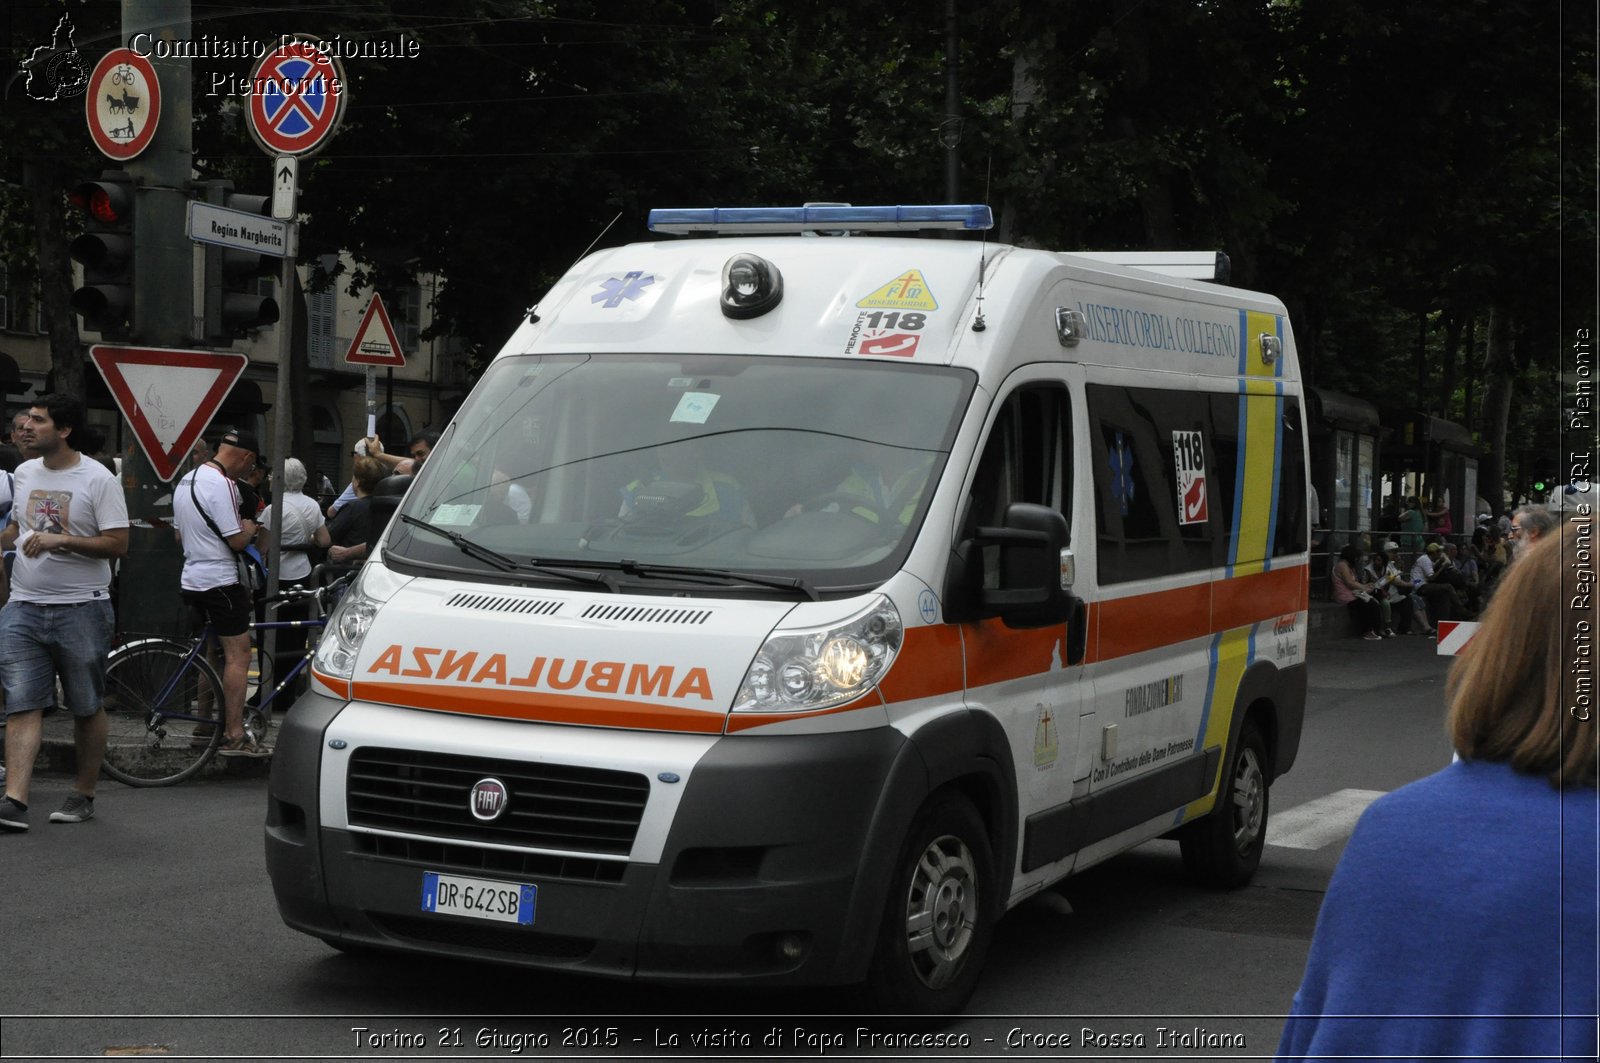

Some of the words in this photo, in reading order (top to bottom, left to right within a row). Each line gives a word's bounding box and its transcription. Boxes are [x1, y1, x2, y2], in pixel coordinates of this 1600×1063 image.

[211, 220, 238, 238] Regina
[240, 226, 282, 246] Margherita
[866, 311, 927, 331] 118
[867, 298, 929, 307] MISERICORDIE
[844, 311, 868, 354] PIEMONTE
[1078, 301, 1176, 351] MISERICORDIA
[1175, 316, 1237, 359] COLLEGNO
[1178, 432, 1204, 471] 118
[1173, 432, 1184, 523] PIEMONTE
[922, 597, 937, 615] 44
[1124, 679, 1166, 719] FONDAZIONE
[1093, 767, 1105, 783] Con
[1110, 755, 1138, 777] Contributo
[1138, 749, 1152, 767] delle
[1152, 747, 1167, 762] Dame
[1166, 738, 1194, 757] Patronesse
[476, 790, 500, 811] FIAT
